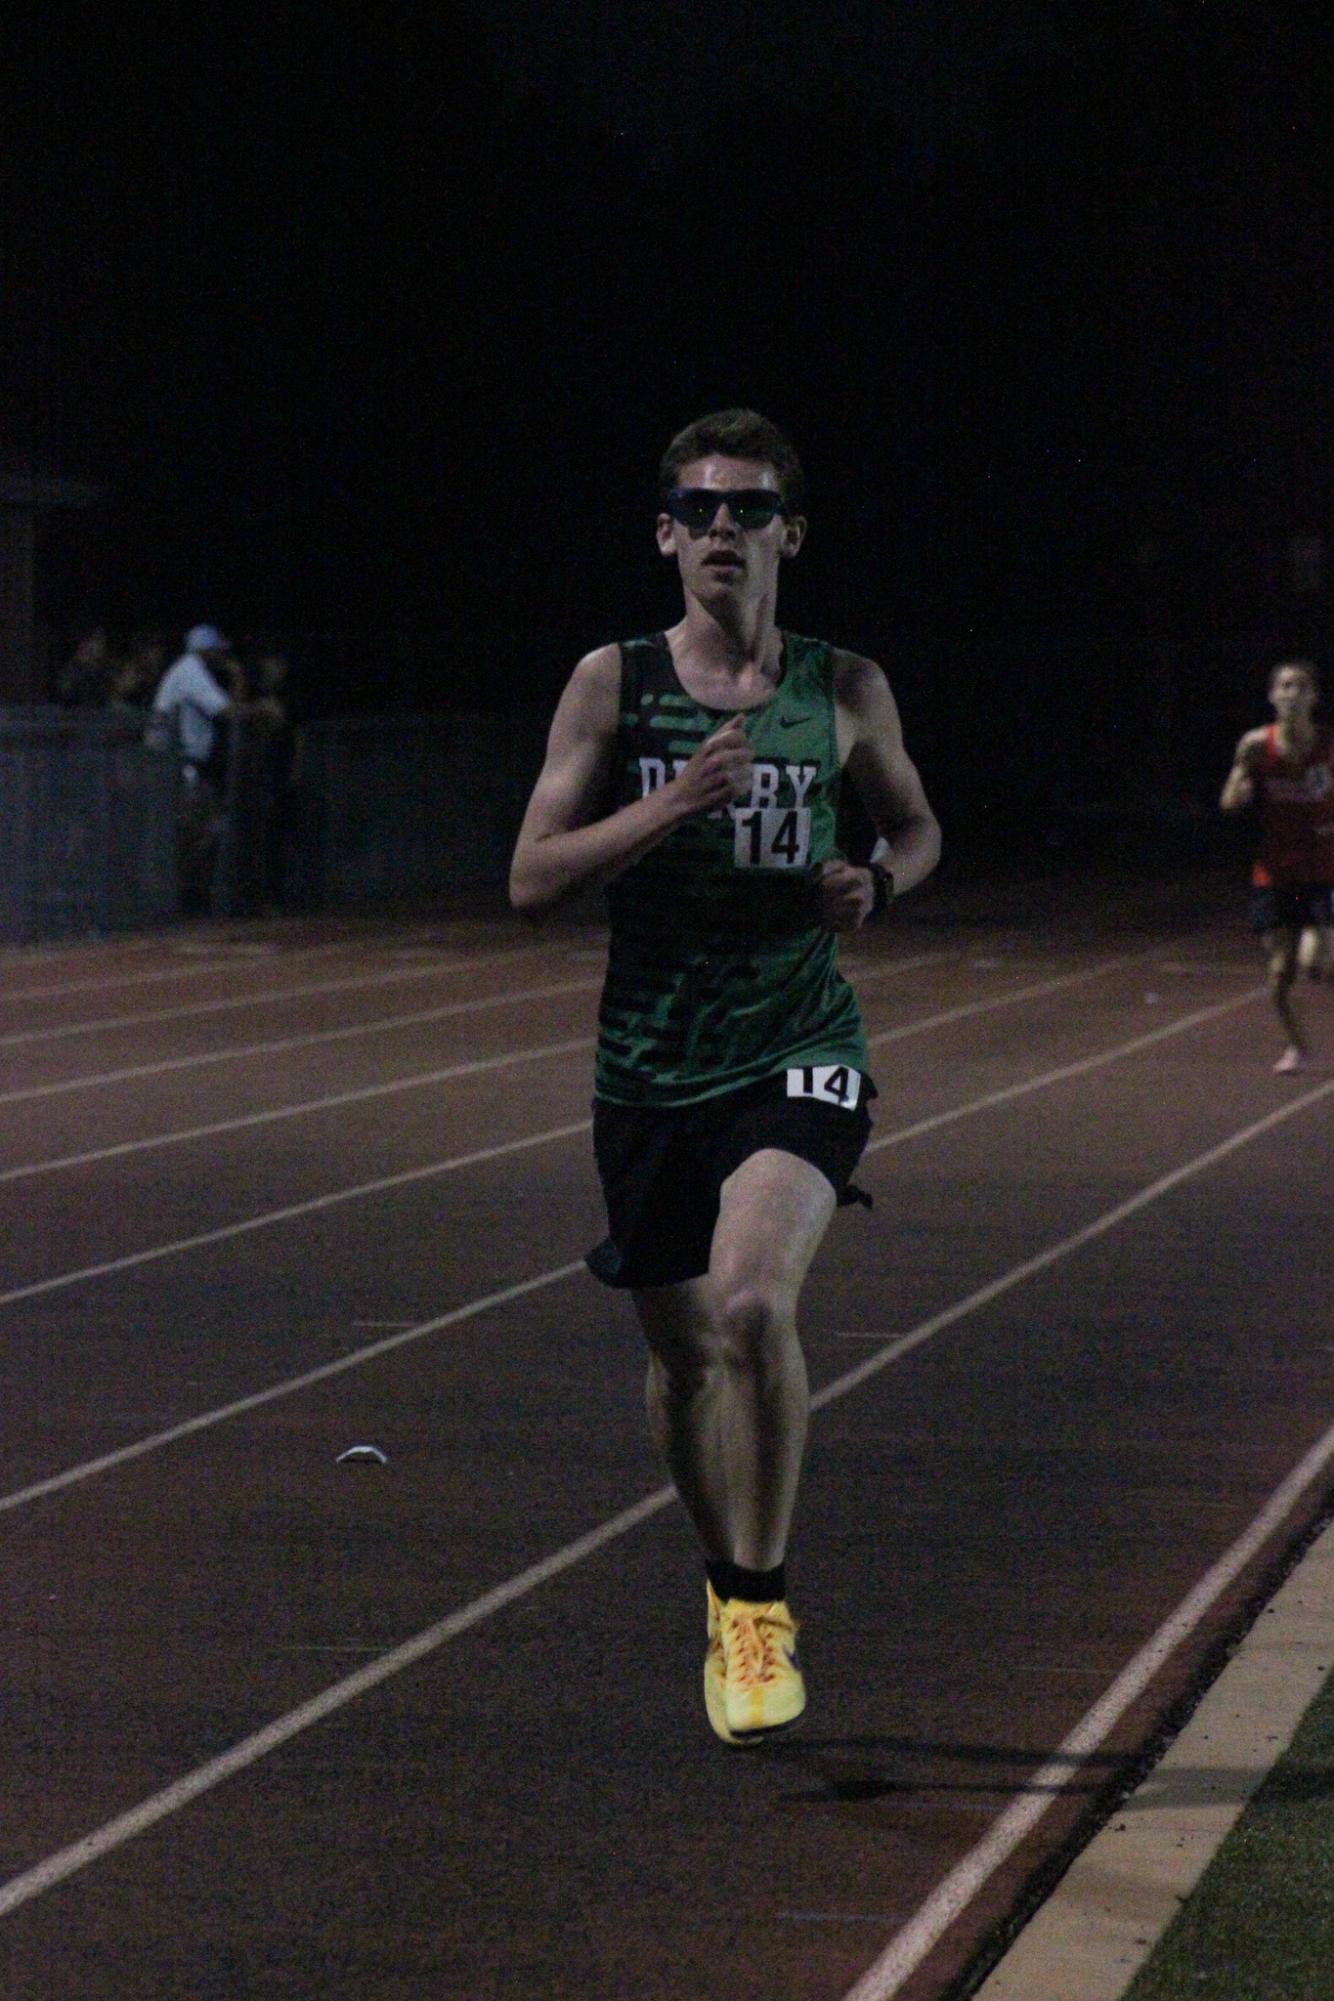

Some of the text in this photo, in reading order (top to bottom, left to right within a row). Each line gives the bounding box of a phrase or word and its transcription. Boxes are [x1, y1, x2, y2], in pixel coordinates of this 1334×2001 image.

[639, 756, 818, 817] DBY
[741, 810, 800, 864] 14
[803, 1066, 850, 1102] 14
